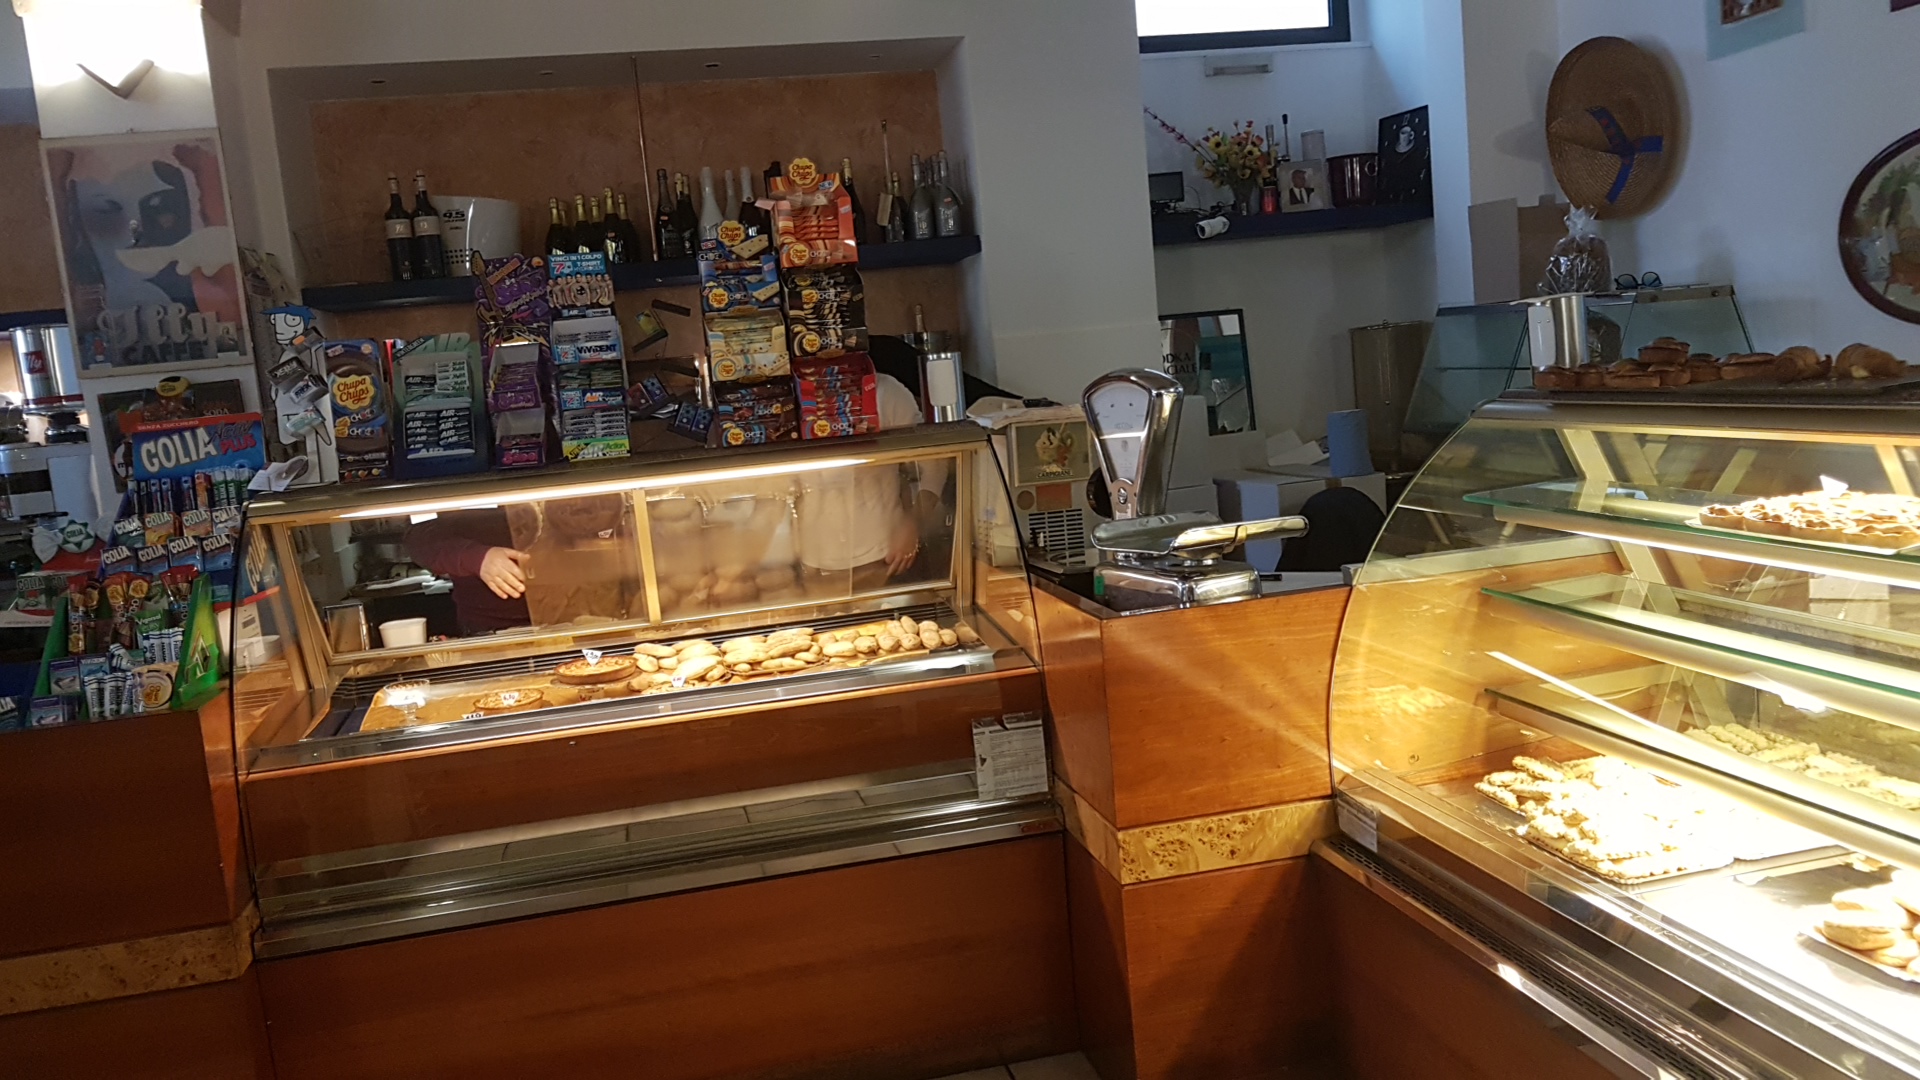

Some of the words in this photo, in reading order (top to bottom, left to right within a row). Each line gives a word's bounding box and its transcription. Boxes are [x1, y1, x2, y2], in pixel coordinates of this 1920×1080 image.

[337, 377, 367, 394] Chupa
[339, 385, 370, 405] Chups
[140, 426, 218, 474] GOLIA
[220, 432, 258, 456] PLUS
[145, 511, 172, 528] GOLIA
[169, 535, 198, 554] GOLIA
[202, 532, 231, 552] GOLIA
[103, 545, 132, 564] GOLIA
[138, 543, 167, 562] GOLIA
